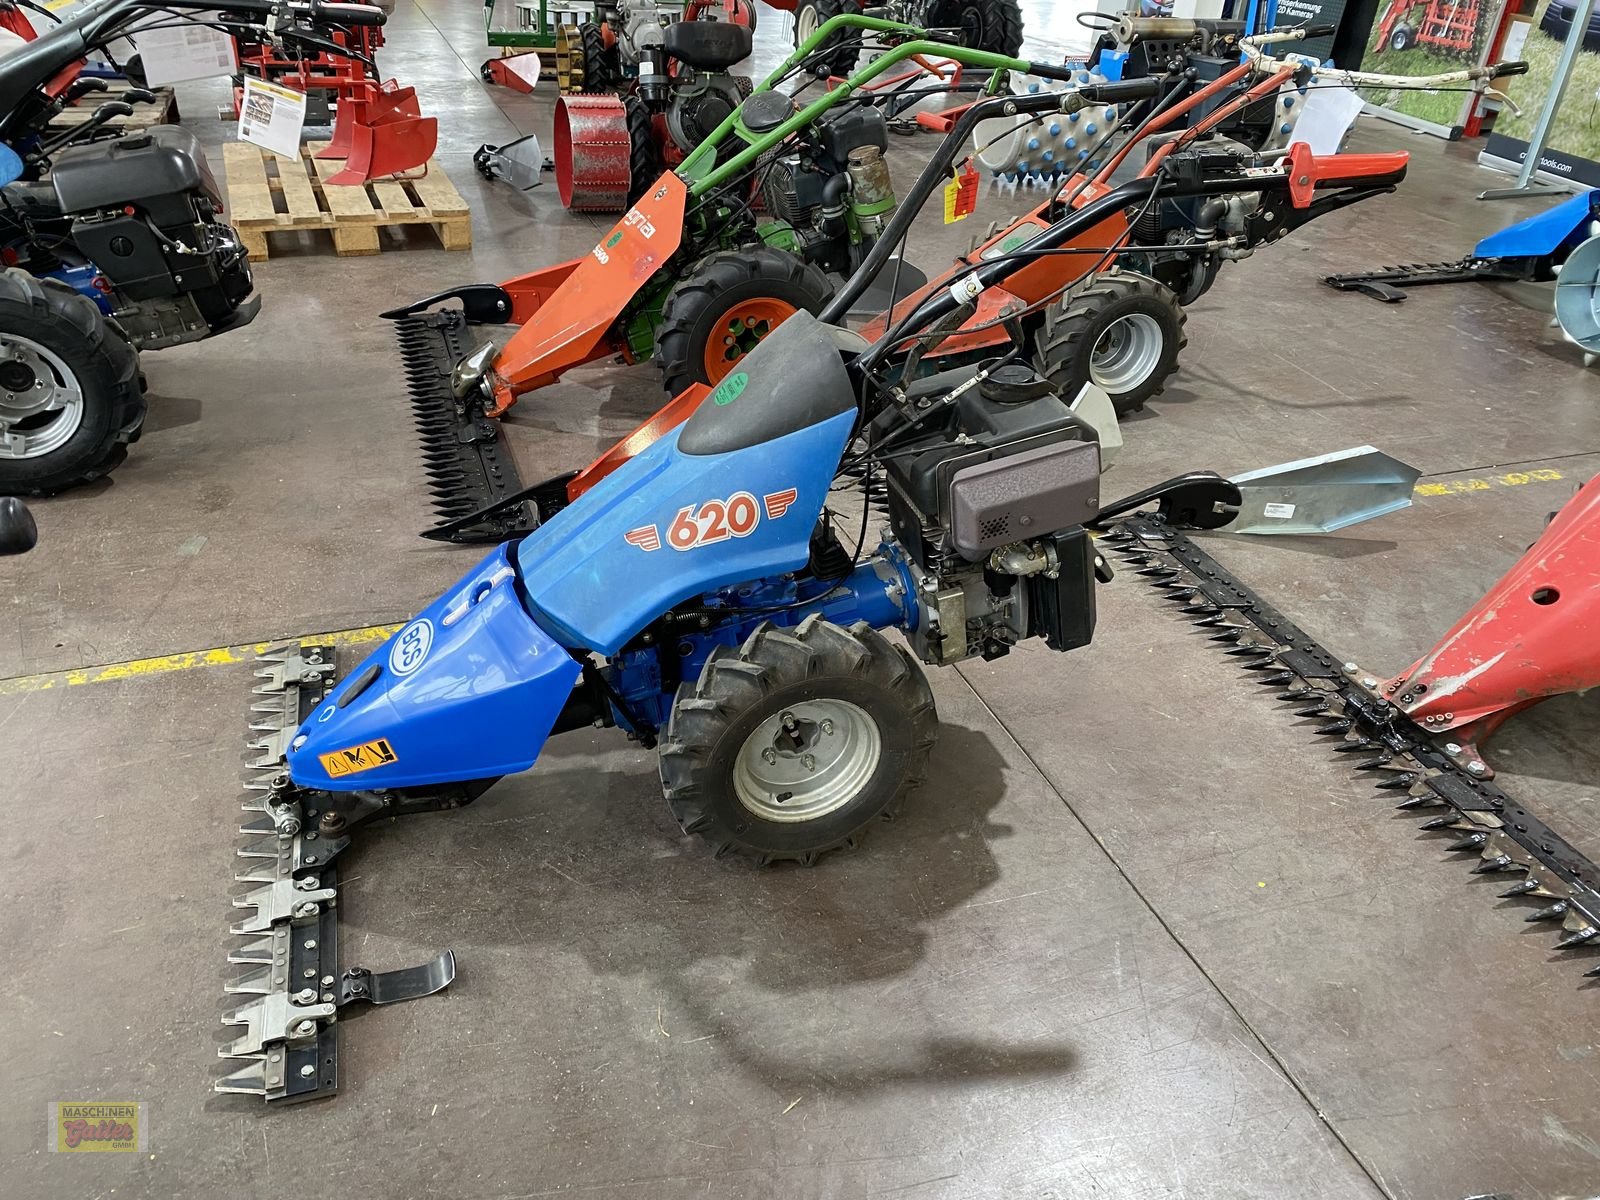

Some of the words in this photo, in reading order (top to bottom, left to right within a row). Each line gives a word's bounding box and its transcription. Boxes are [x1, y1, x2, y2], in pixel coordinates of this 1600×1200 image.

[1287, 7, 1314, 19] Kameras
[668, 493, 758, 550] 620
[402, 626, 422, 667] BCS
